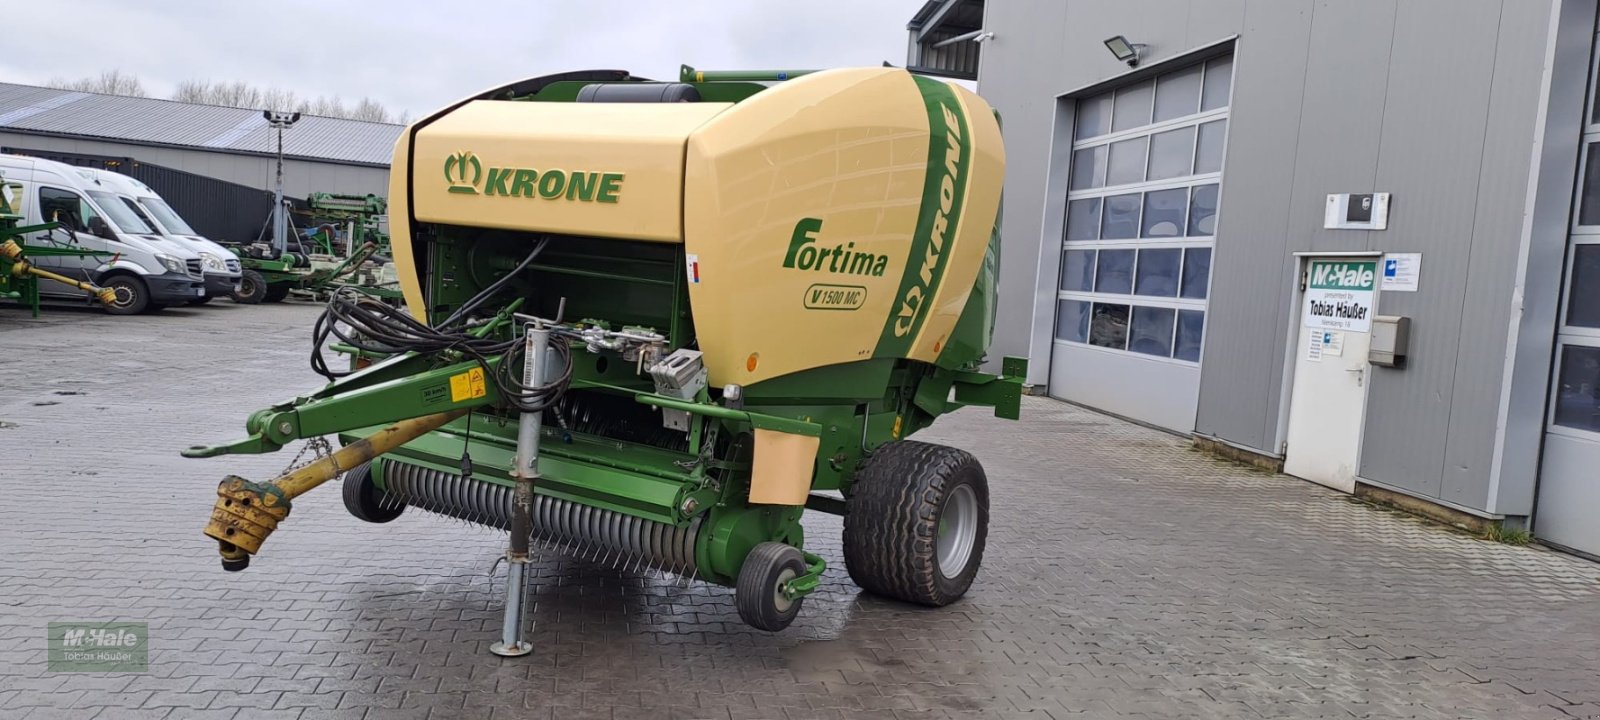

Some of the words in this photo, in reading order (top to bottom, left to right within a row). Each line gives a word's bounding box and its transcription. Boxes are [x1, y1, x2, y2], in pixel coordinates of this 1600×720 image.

[484, 167, 625, 204] KRONE
[919, 101, 961, 288] KRONE
[783, 217, 888, 276] Fortima
[1313, 264, 1373, 287] McHale
[811, 289, 821, 304] V
[821, 289, 843, 305] 1500
[843, 290, 861, 305] MC
[1310, 300, 1334, 317] Tobias
[1336, 300, 1367, 320] Häußer
